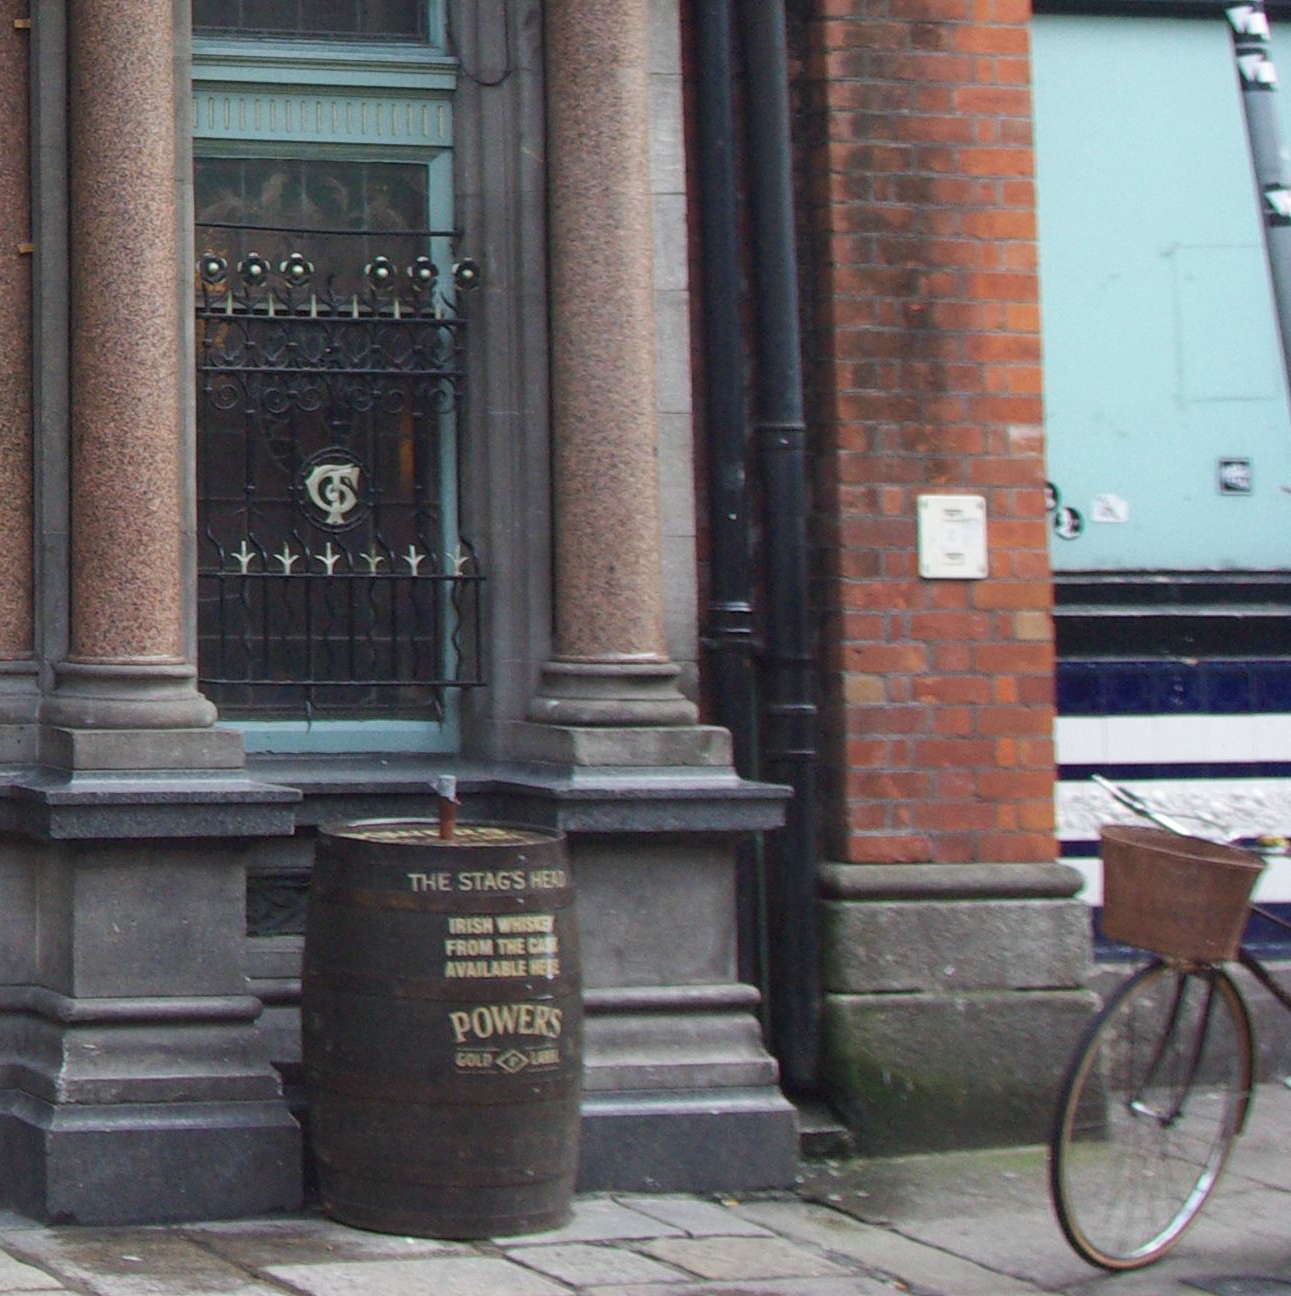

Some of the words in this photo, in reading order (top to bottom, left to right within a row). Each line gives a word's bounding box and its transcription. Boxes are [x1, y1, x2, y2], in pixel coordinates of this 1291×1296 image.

[408, 872, 452, 893] THE
[458, 871, 527, 892] STAG'S
[529, 869, 568, 889] HEAD
[448, 916, 494, 934] IRISH
[497, 915, 556, 933] WHISKEY
[445, 938, 495, 957] FROM
[497, 937, 526, 955] THE
[445, 960, 528, 979] AVAILABLE
[529, 958, 560, 977] HERE
[449, 1003, 562, 1043] POWERS
[456, 1051, 494, 1068] GOLD
